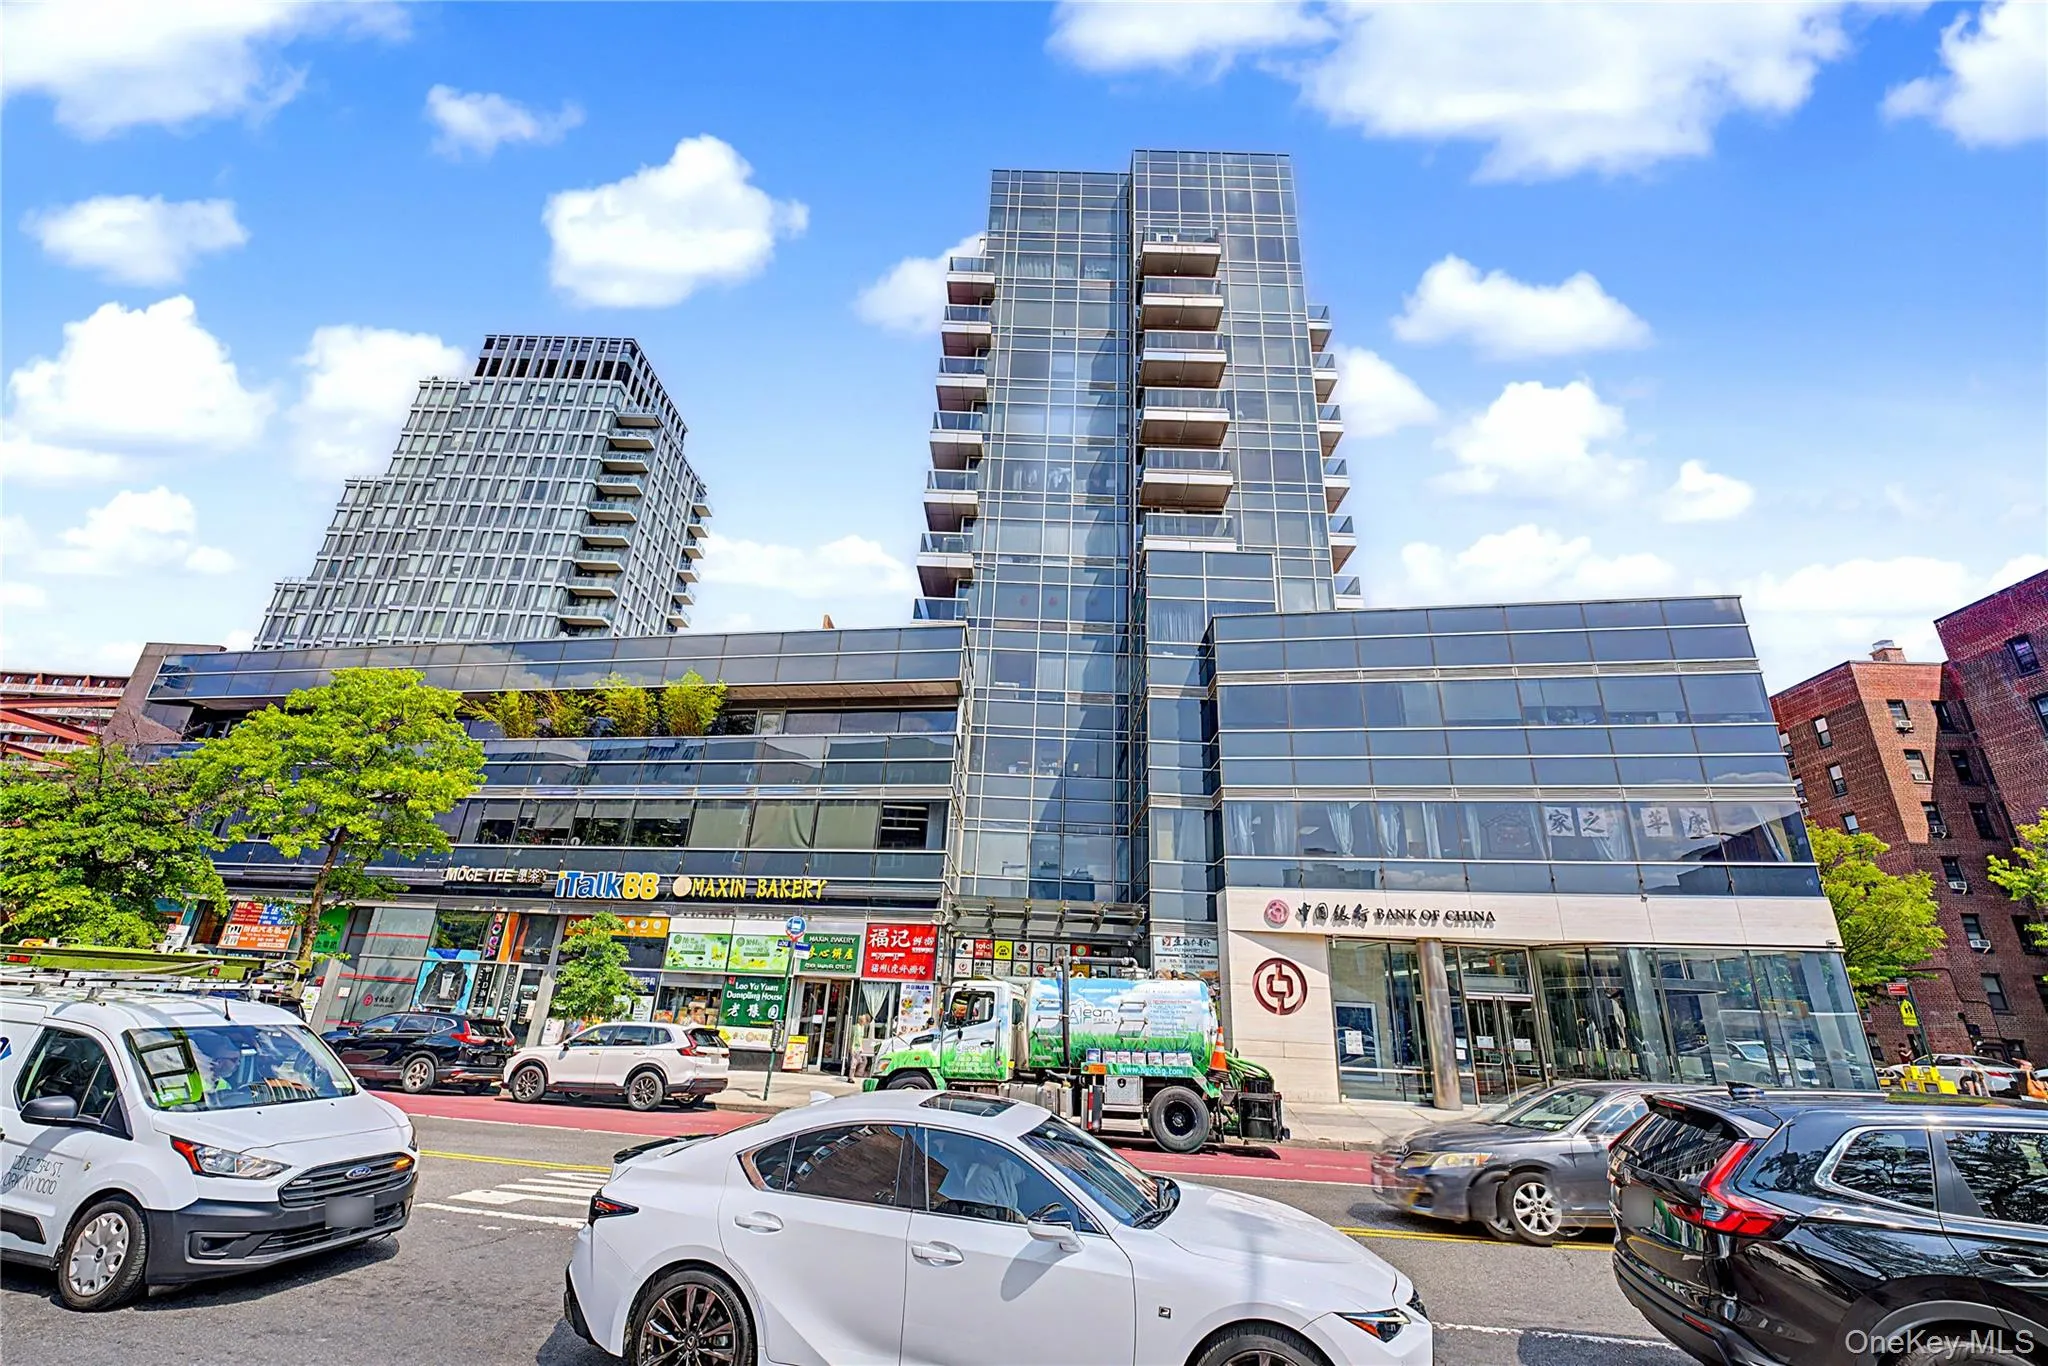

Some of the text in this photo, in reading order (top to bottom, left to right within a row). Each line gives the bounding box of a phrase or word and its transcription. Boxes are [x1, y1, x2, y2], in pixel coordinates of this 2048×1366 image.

[487, 868, 513, 882] TEE
[555, 870, 659, 900] iTalkBB
[691, 877, 827, 900] MAXIN BAKERY
[1376, 907, 1417, 921] BANK
[1420, 909, 1440, 921] OF
[1445, 909, 1496, 922] CHINA
[831, 936, 856, 944] BAKERY
[868, 928, 911, 948] 福记
[735, 981, 779, 992] Lao Yu Yuan
[726, 990, 783, 1001] Dumpling House
